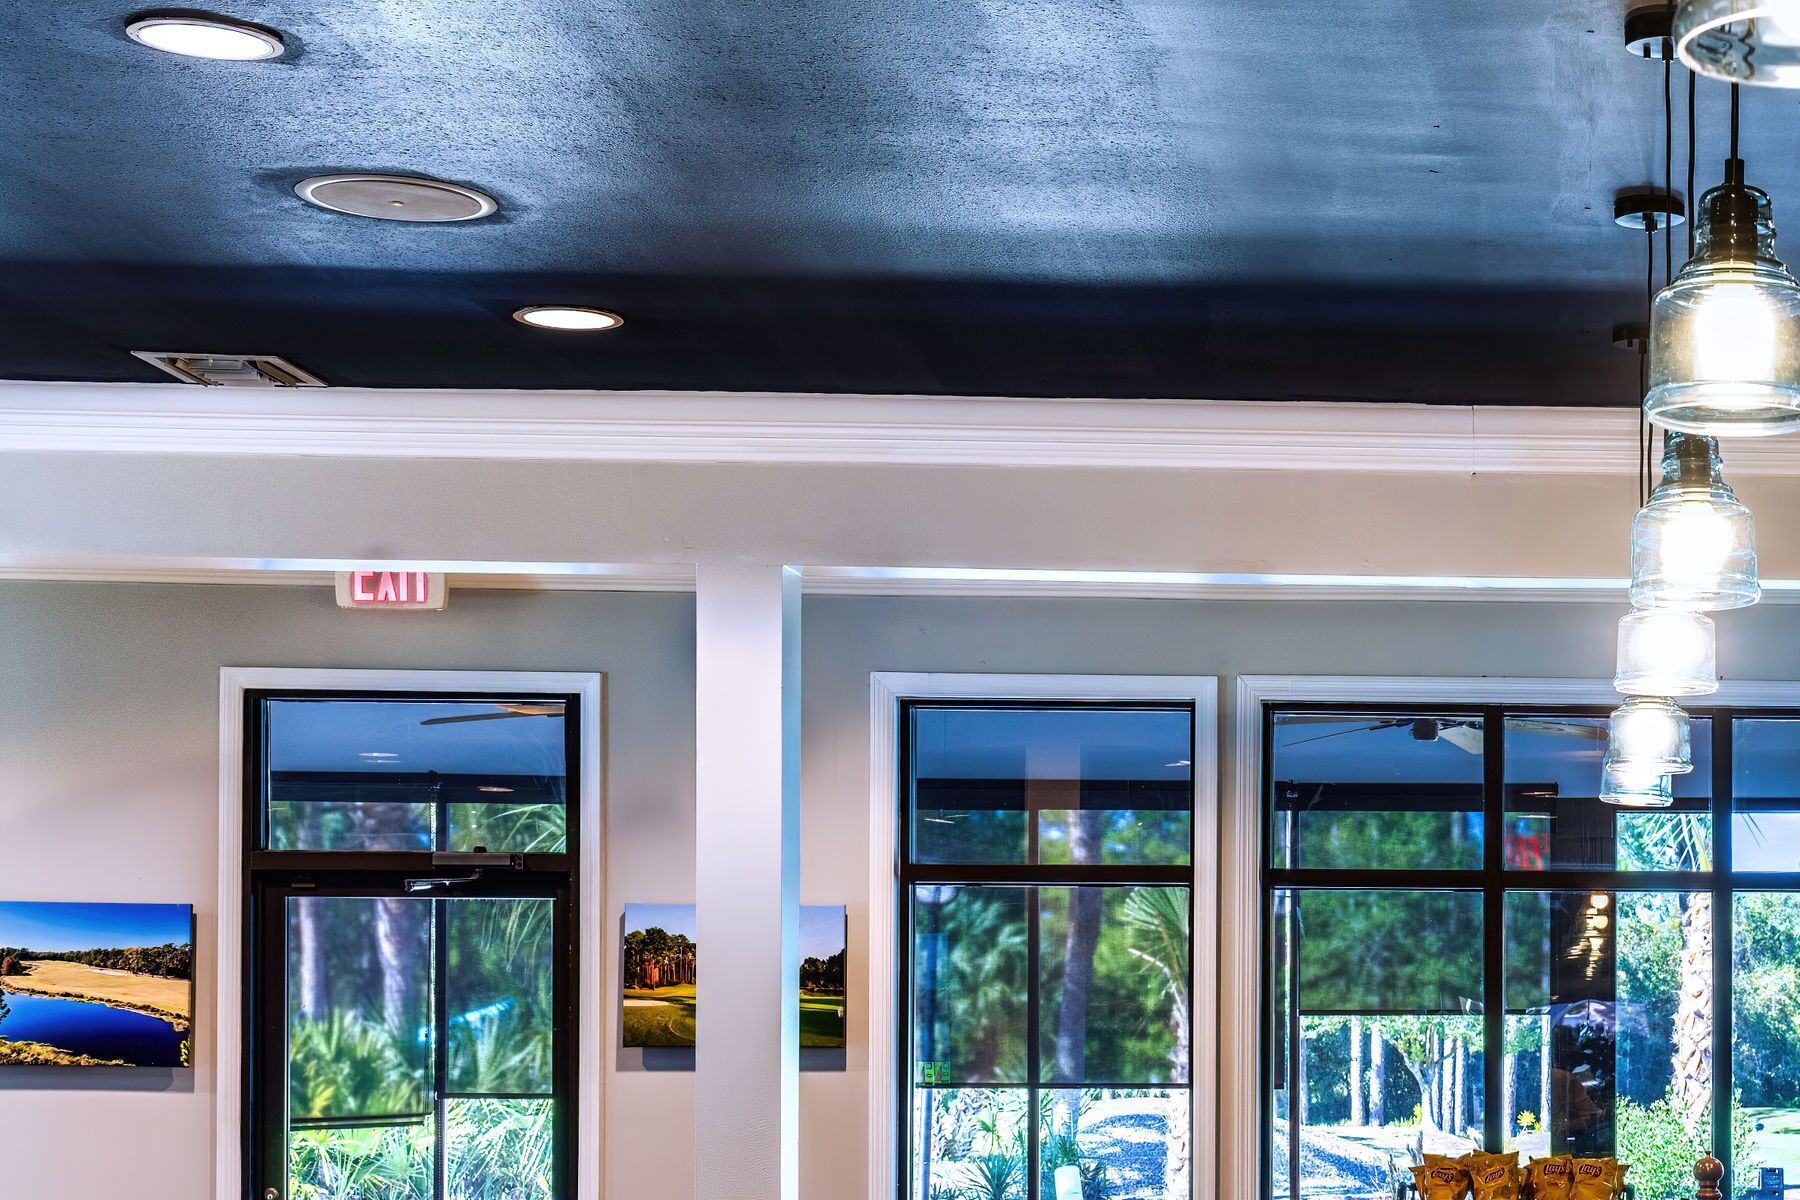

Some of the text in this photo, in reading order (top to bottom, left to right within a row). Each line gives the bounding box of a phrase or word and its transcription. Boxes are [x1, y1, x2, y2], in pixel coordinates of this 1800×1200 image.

[352, 570, 428, 603] EXIT
[1486, 1168, 1505, 1182] Lay's
[1545, 1164, 1566, 1175] Lay's
[1580, 1164, 1601, 1176] Lay's
